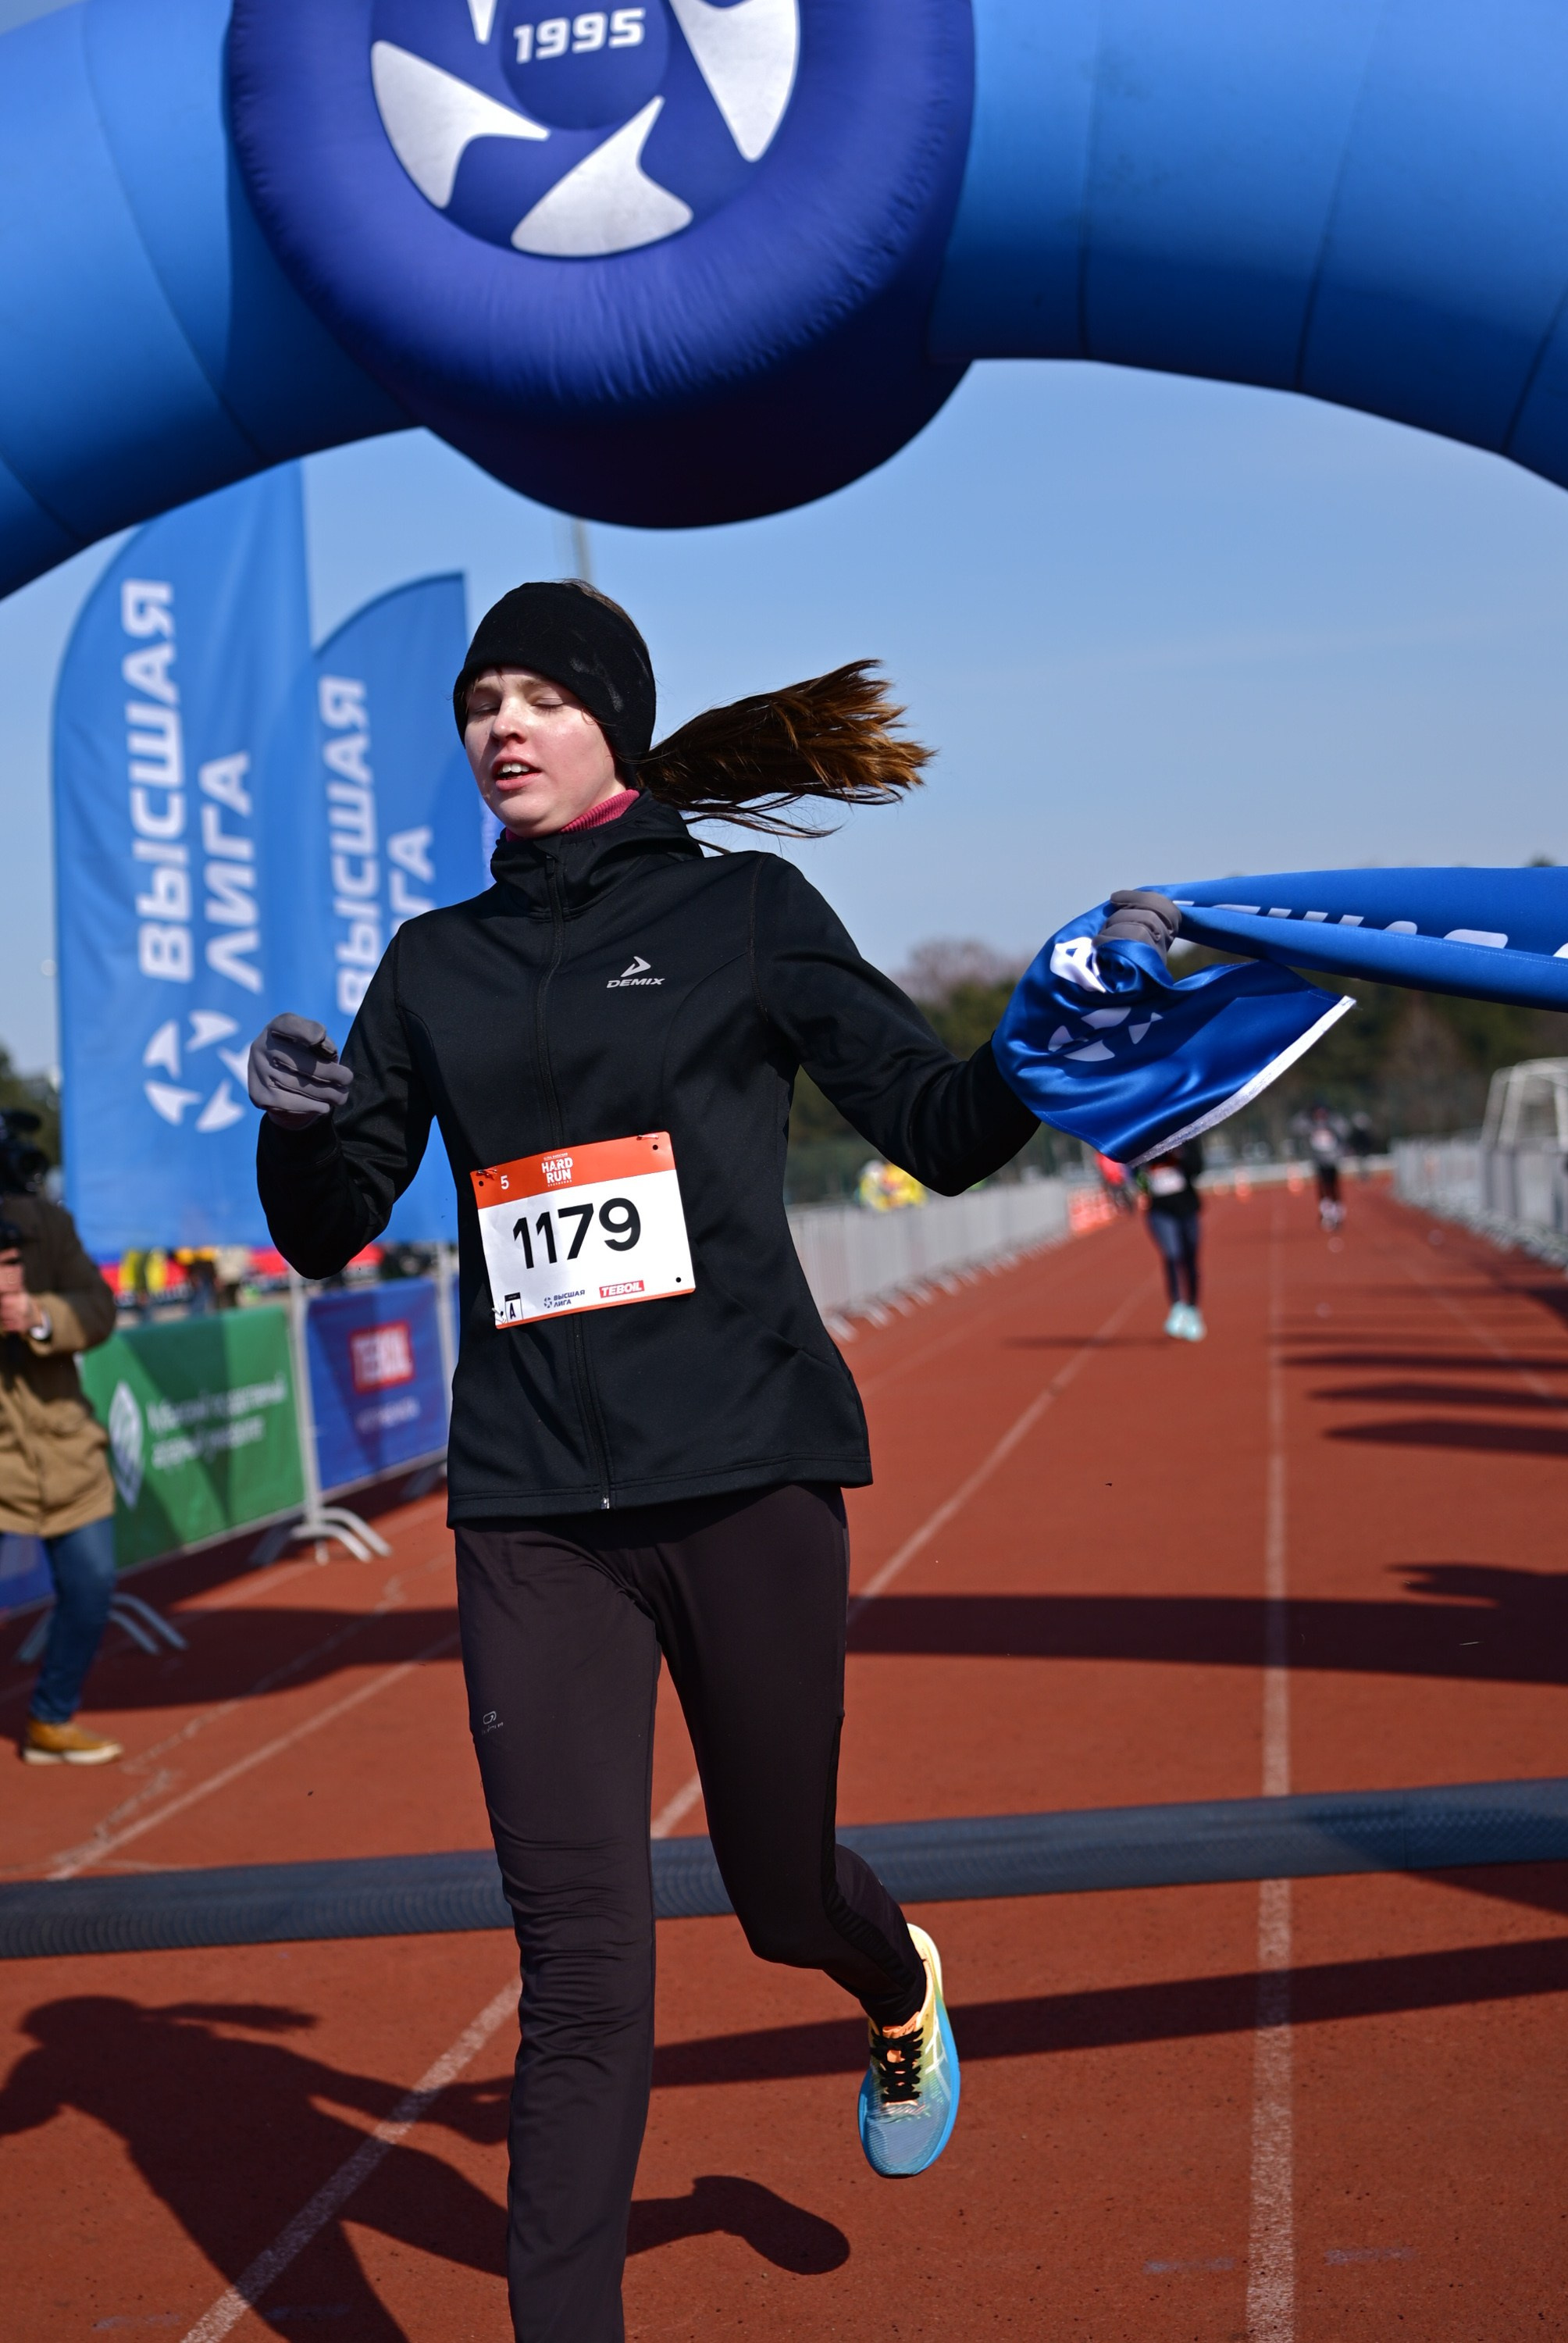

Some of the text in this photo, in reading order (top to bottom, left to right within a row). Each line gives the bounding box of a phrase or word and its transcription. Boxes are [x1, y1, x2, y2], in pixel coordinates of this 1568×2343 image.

[512, 6, 647, 65] 1995
[121, 578, 194, 983] ВЫСШАЯ
[198, 751, 264, 994] ЛИГА
[606, 978, 665, 989] DEMIX
[541, 1157, 573, 1173] HARD
[500, 1175, 509, 1189] 5
[547, 1168, 572, 1183] RUN
[512, 1197, 641, 1269] 1179
[554, 1289, 586, 1301] ВЫСШАЯ
[600, 1281, 643, 1296] TEBOIL
[554, 1300, 572, 1308] ЛИГА
